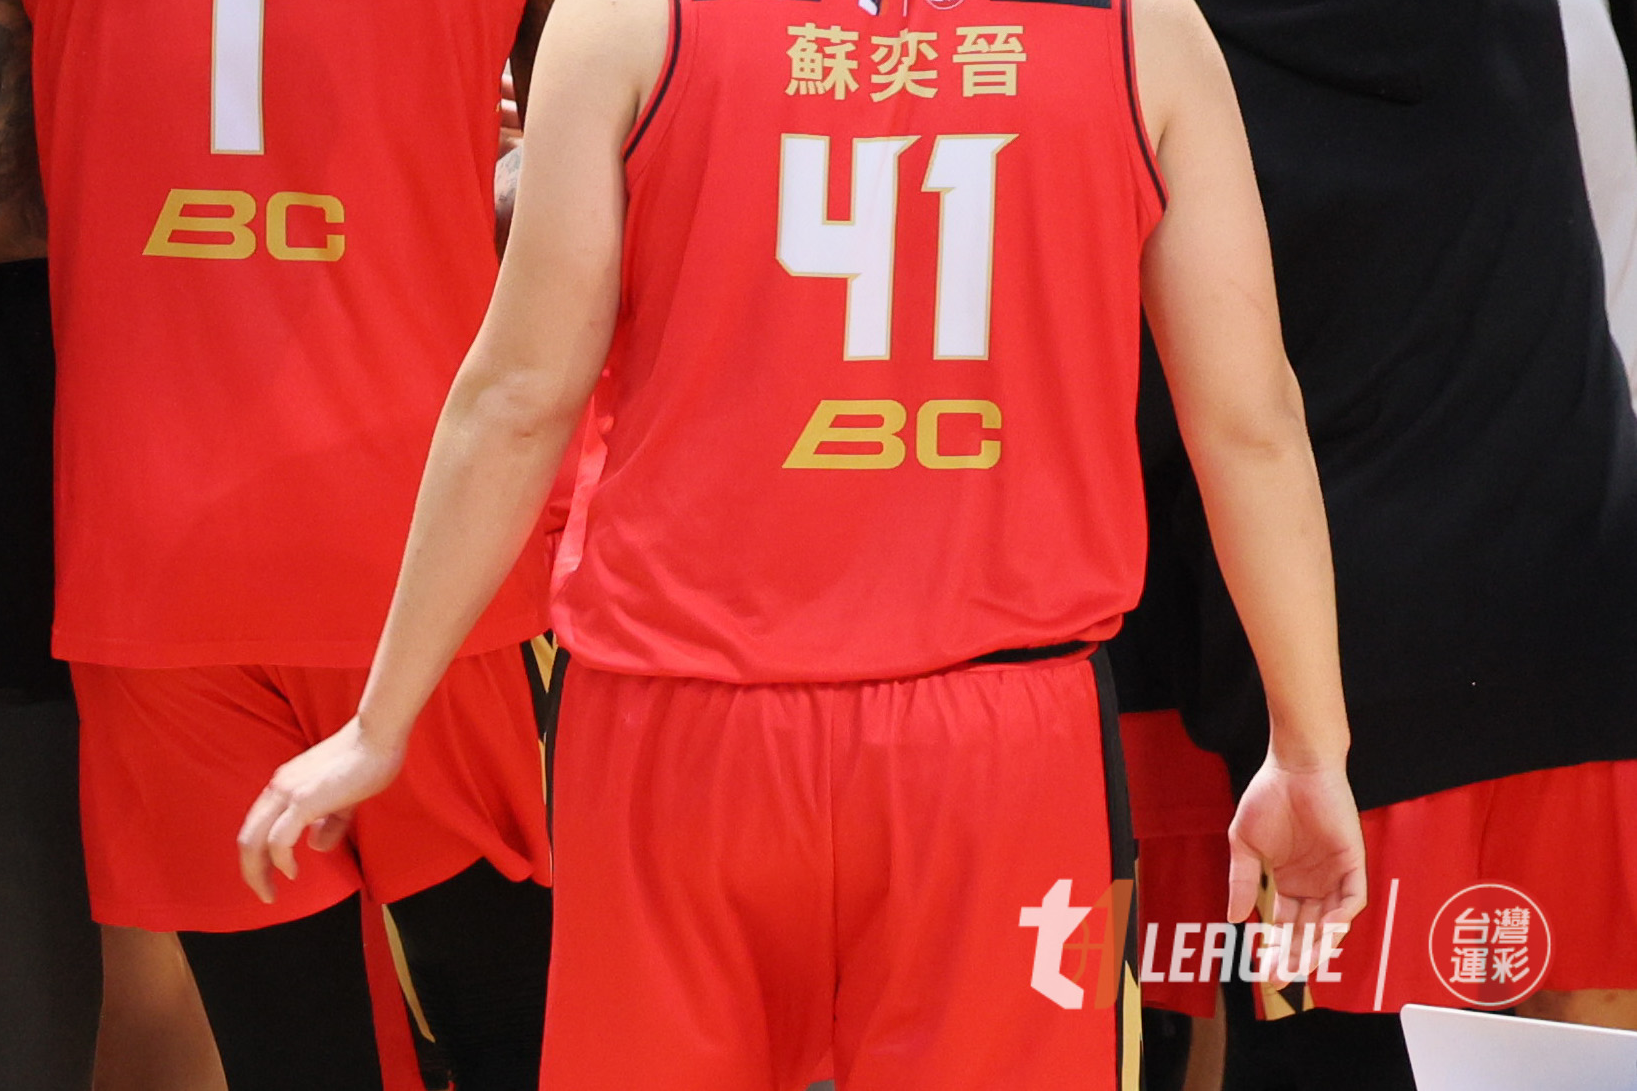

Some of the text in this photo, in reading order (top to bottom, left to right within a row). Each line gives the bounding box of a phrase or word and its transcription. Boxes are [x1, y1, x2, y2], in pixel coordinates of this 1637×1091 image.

[785, 22, 1027, 102] 蘇奕晉
[142, 188, 345, 262] BC
[775, 133, 1019, 361] 41
[782, 399, 1002, 470] BC
